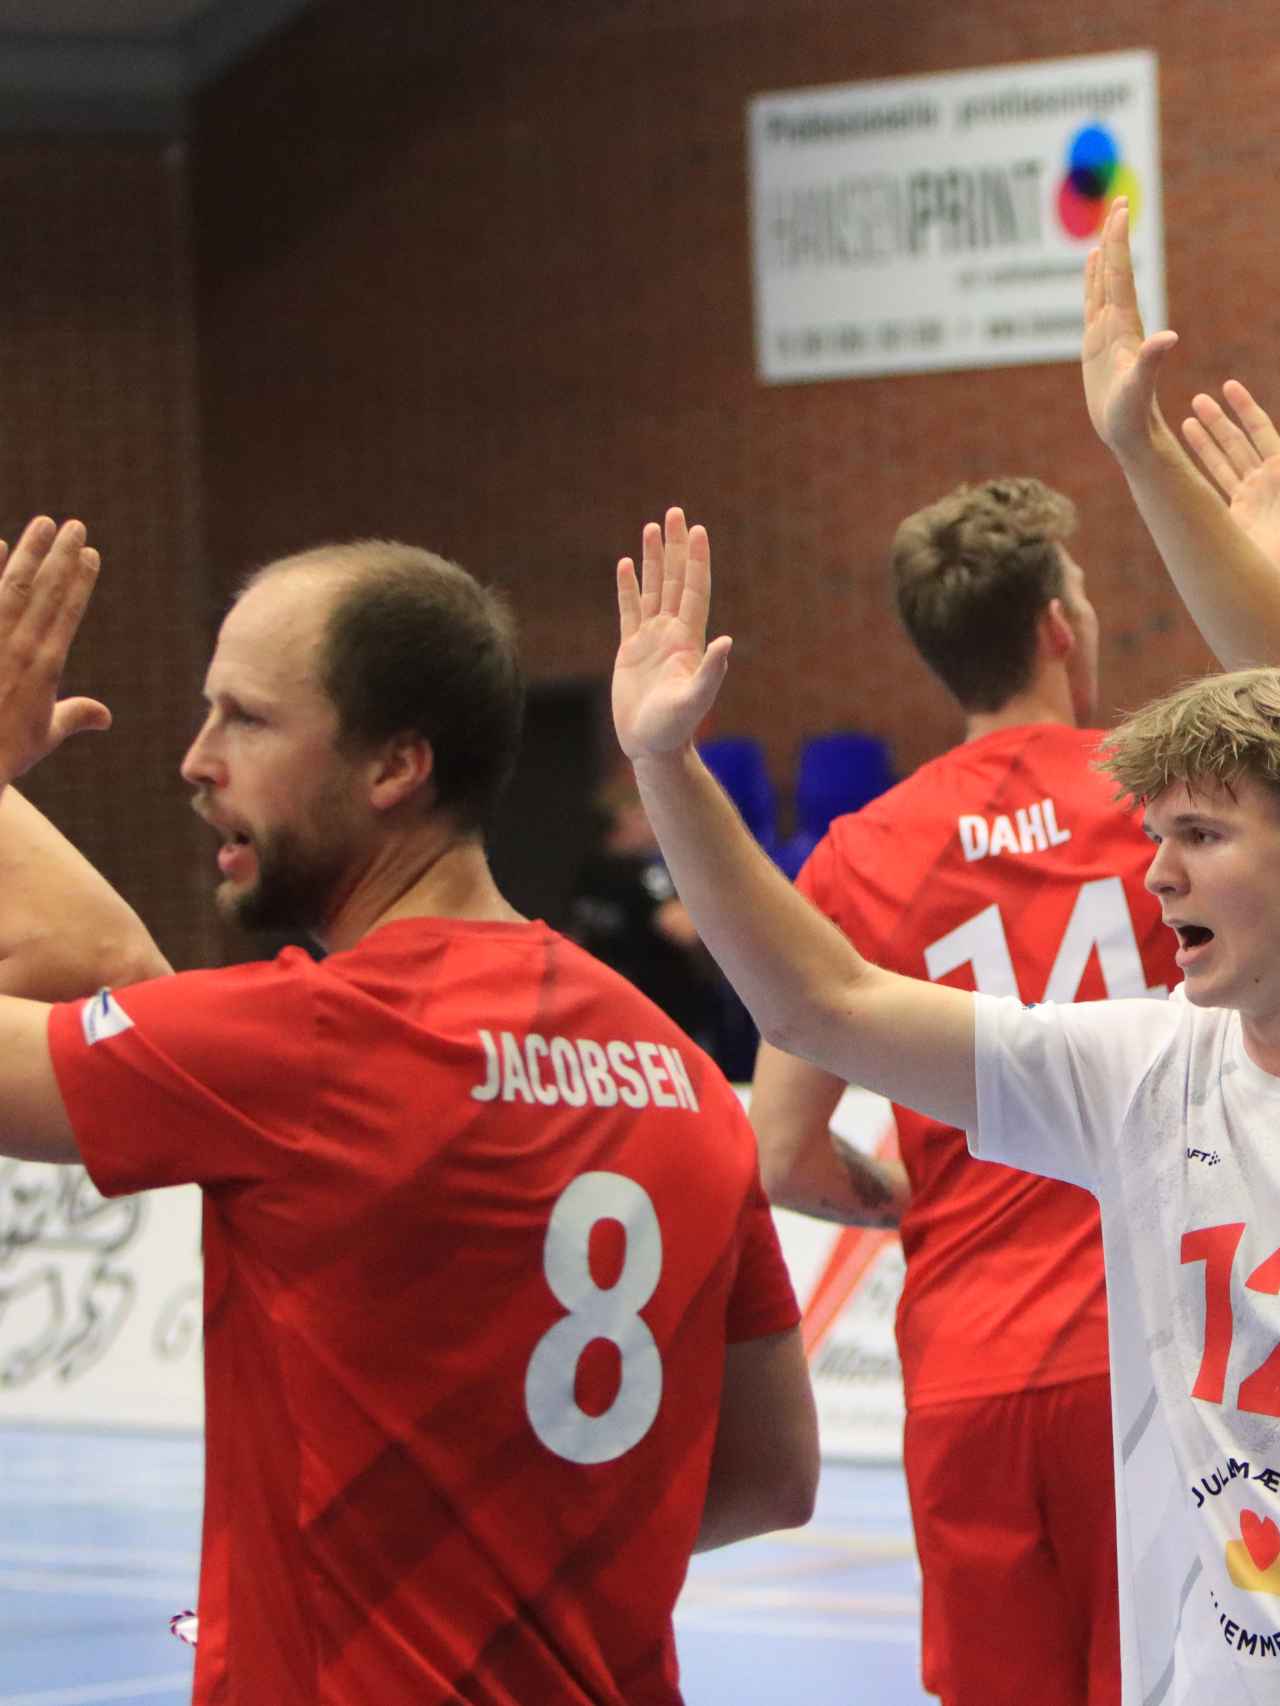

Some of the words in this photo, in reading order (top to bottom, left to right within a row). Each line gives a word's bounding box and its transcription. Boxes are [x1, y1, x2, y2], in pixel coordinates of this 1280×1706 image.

[958, 798, 1072, 863] DAHL
[923, 875, 1169, 1003] 14
[471, 1029, 701, 1113] JACOBSEN
[525, 1171, 663, 1466] 8
